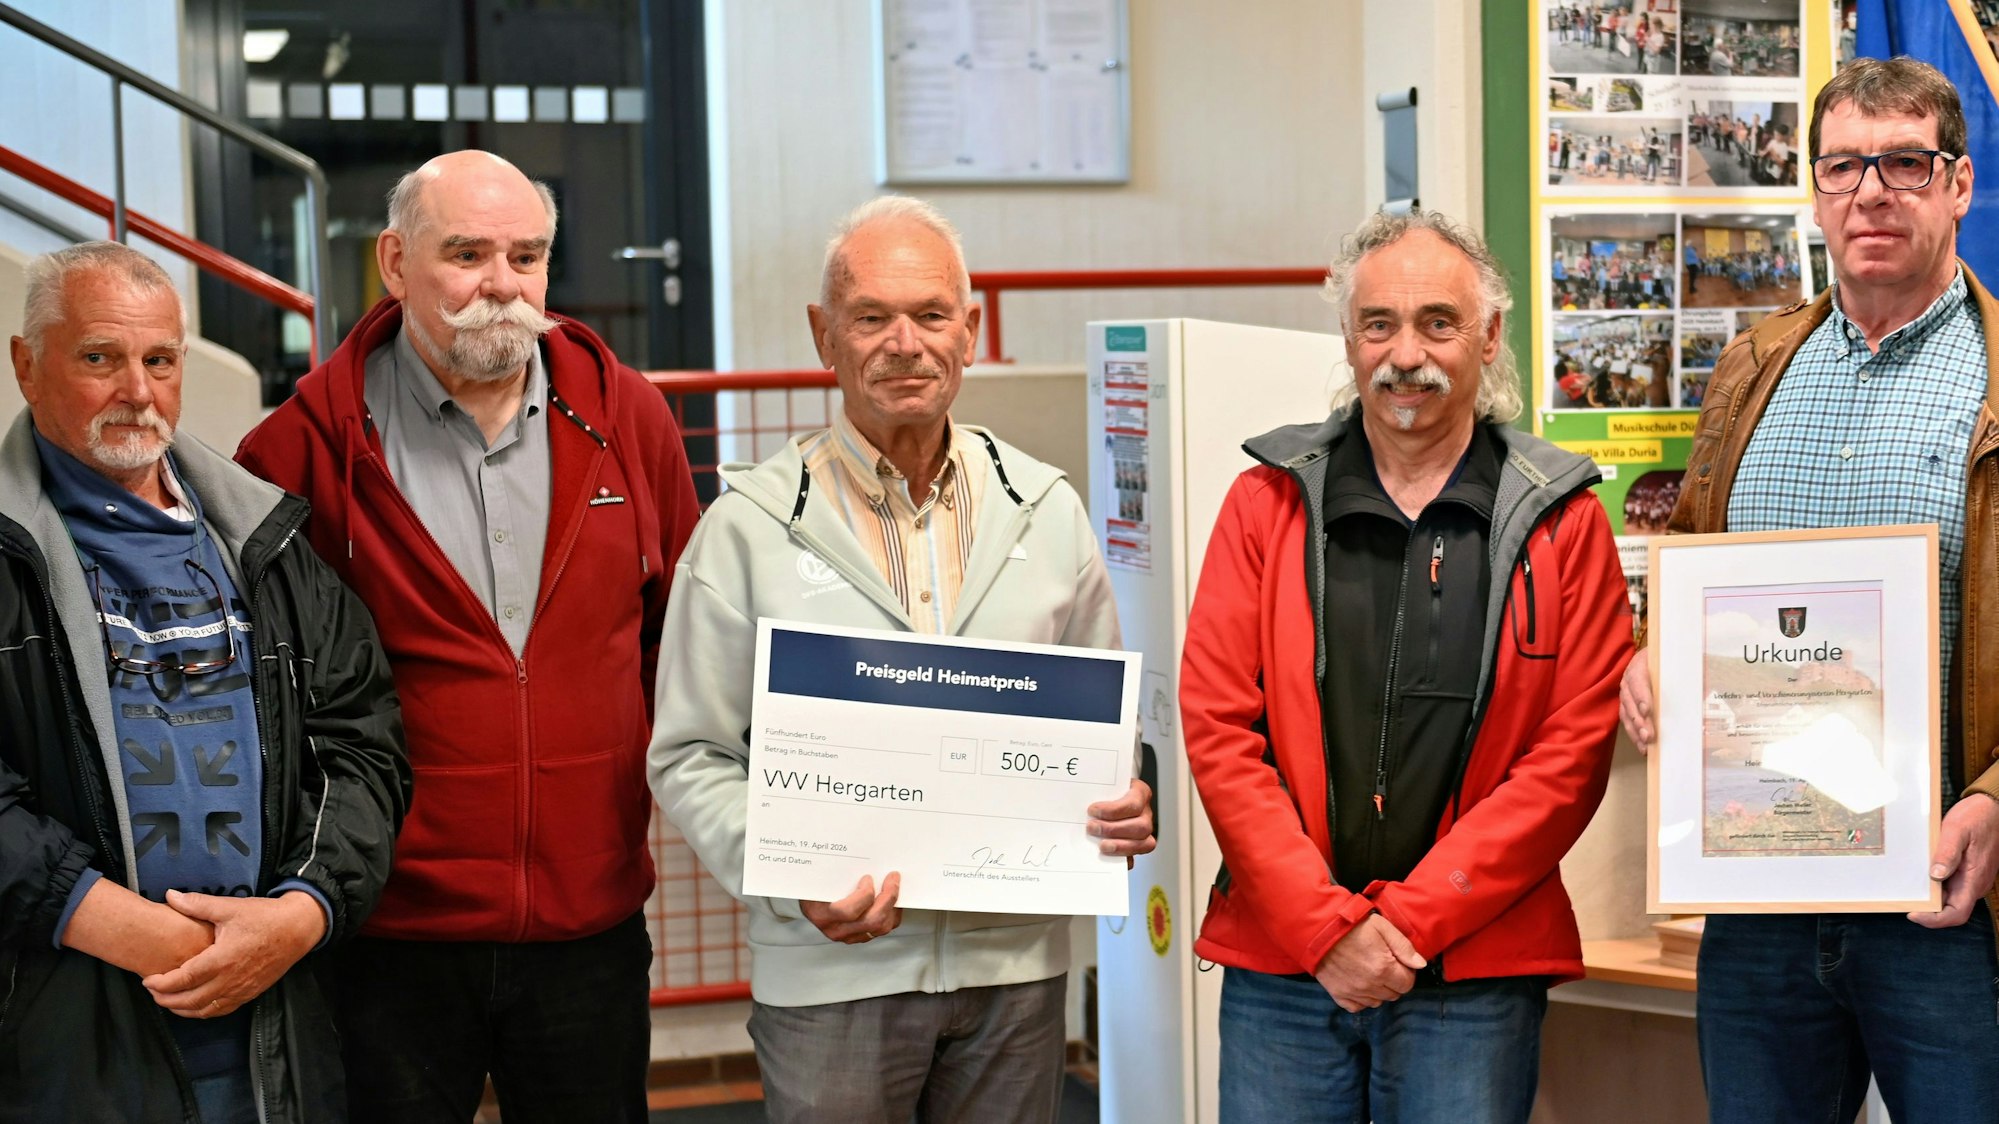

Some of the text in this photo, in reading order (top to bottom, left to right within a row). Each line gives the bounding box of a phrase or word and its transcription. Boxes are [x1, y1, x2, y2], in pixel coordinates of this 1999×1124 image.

[1613, 421, 1695, 433] Musikschule Dü
[1602, 448, 1626, 458] Villa
[1629, 447, 1657, 458] Duria
[149, 632, 168, 642] NOW
[179, 628, 200, 637] YOR
[1743, 641, 1843, 664] Urkunde
[856, 661, 1037, 692] Preisgeld Heimatpreis
[765, 728, 827, 741] Fünfhundert Euro
[764, 745, 788, 756] Betrag
[798, 748, 839, 760] Buchstaben
[950, 752, 967, 761] EUR
[1066, 757, 1079, 776] €
[763, 769, 924, 802] VVV Hergarten
[759, 837, 848, 852] Heimbach, 19. April 2026
[758, 854, 812, 865] Ort und Datum
[943, 870, 1041, 882] Unterschrift des Ausstellers
